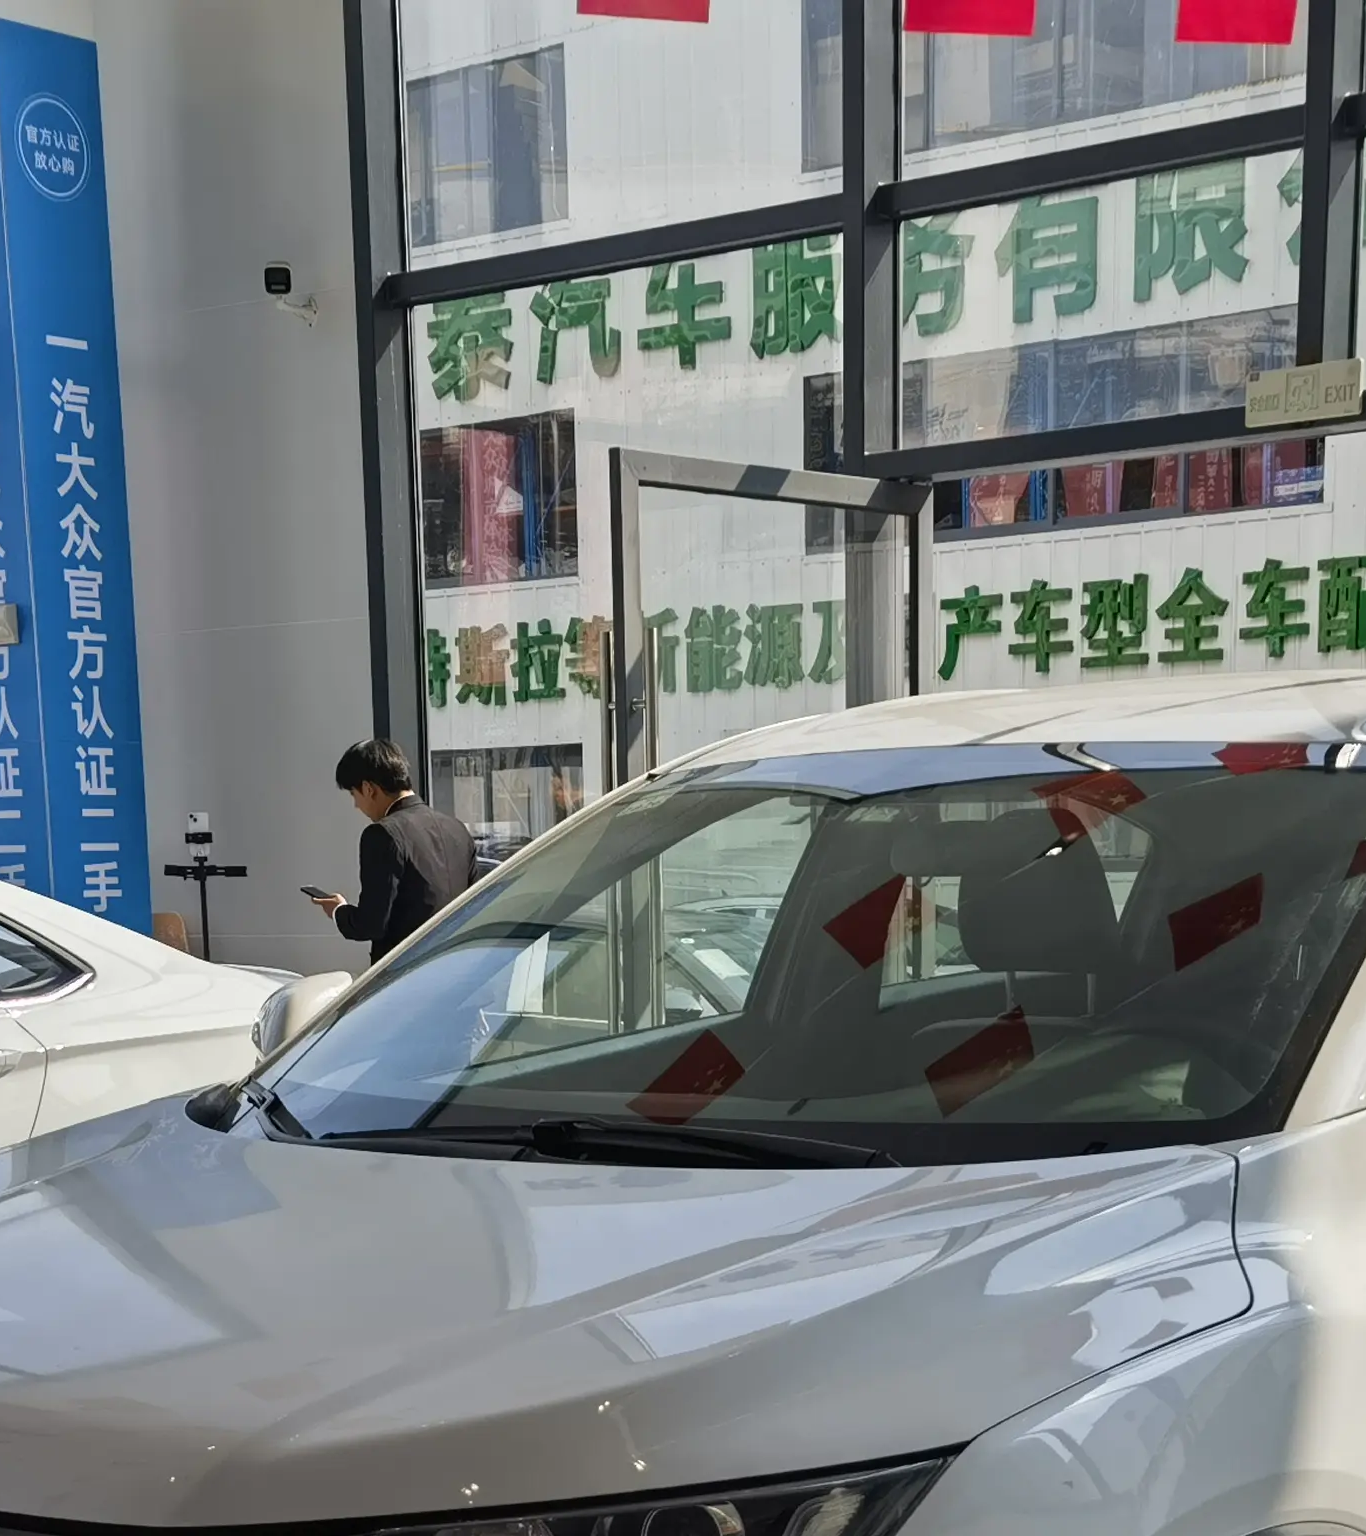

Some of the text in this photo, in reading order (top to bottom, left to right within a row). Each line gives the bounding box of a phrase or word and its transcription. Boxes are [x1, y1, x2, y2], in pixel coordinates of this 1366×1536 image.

[25, 124, 80, 152] 官方认证
[35, 151, 75, 176] 放心购
[1324, 382, 1356, 404] EXIT
[46, 334, 122, 913] 一汽大众官方认证二手
